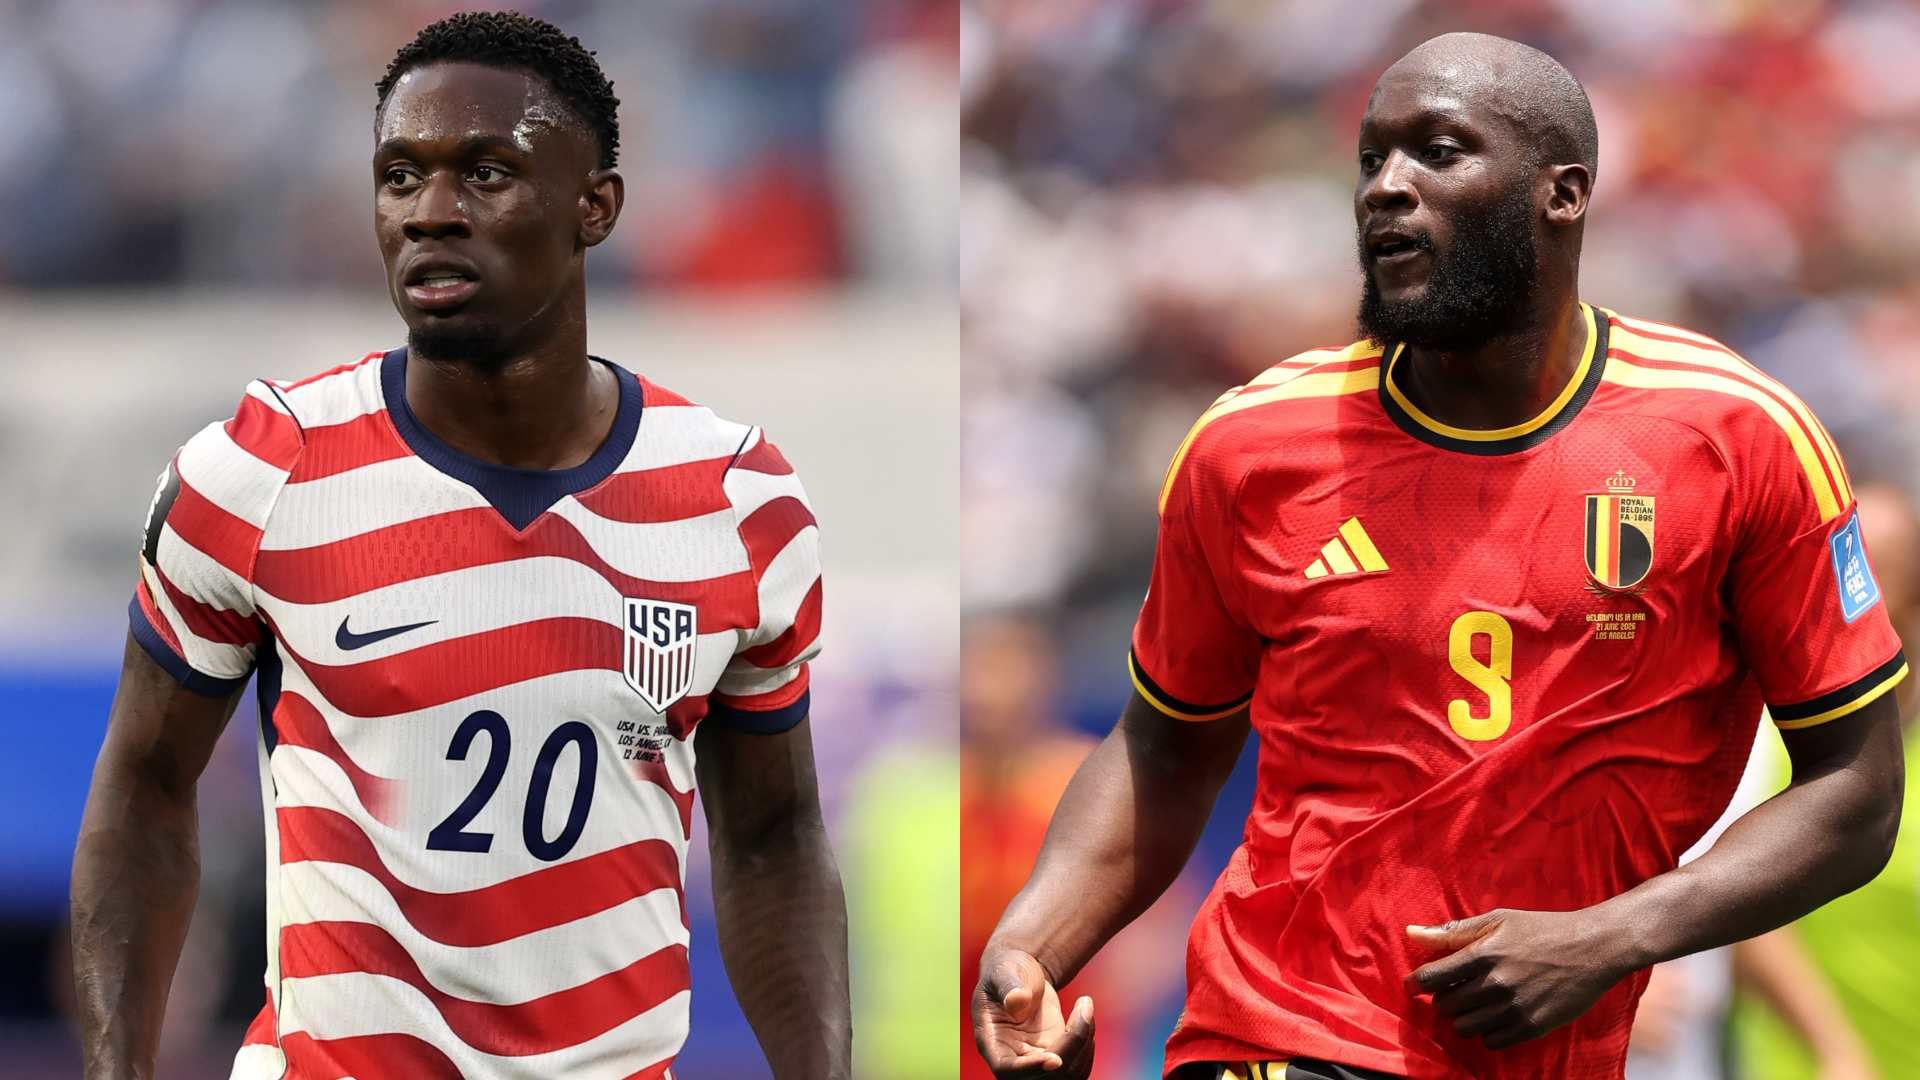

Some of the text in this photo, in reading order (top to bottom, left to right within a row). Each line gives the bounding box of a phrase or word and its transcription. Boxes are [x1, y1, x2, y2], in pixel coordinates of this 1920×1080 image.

[1620, 498, 1645, 506] ROYAL
[1620, 506, 1653, 514] BELGIAN
[1585, 613, 1614, 622] BELGIUM
[629, 603, 692, 648] USA
[1596, 622, 1603, 631] 21
[1604, 622, 1619, 631] JUNE
[1595, 631, 1636, 640] LOS ANGELES
[1447, 610, 1513, 742] 9
[616, 720, 635, 732] USA
[617, 734, 635, 746] LOS
[623, 748, 632, 760] 12
[632, 750, 657, 762] JUNE
[425, 709, 598, 862] 20
